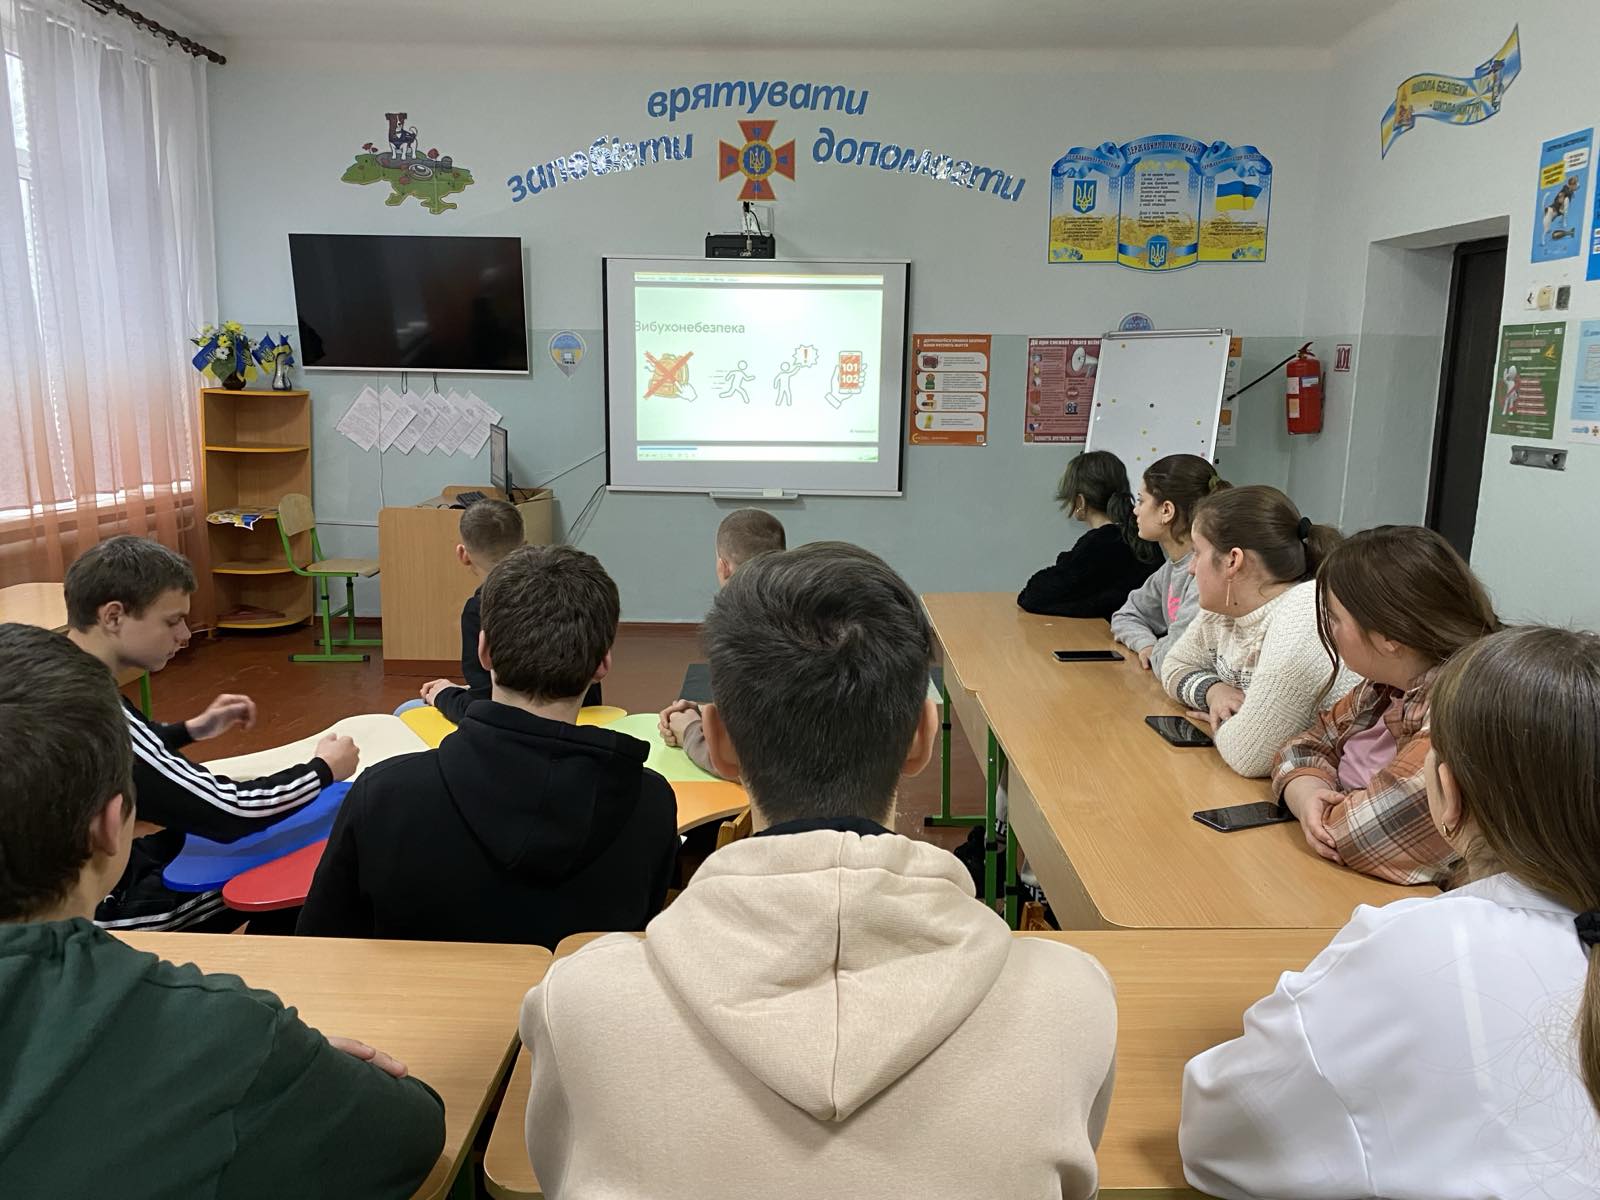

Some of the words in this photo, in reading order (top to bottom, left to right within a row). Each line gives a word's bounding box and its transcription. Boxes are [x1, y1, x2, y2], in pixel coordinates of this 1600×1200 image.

[1411, 79, 1435, 94] ШКОЛА
[1436, 80, 1469, 98] БЕЗПЕКИ
[647, 80, 868, 120] врятувати
[1432, 100, 1457, 113] ШКОЛА
[507, 131, 693, 202] запобігти
[812, 126, 1026, 202] допомогти
[635, 320, 745, 335] Вибухонебезпека
[1335, 346, 1351, 369] 101
[842, 363, 858, 371] 101
[842, 375, 859, 384] 102
